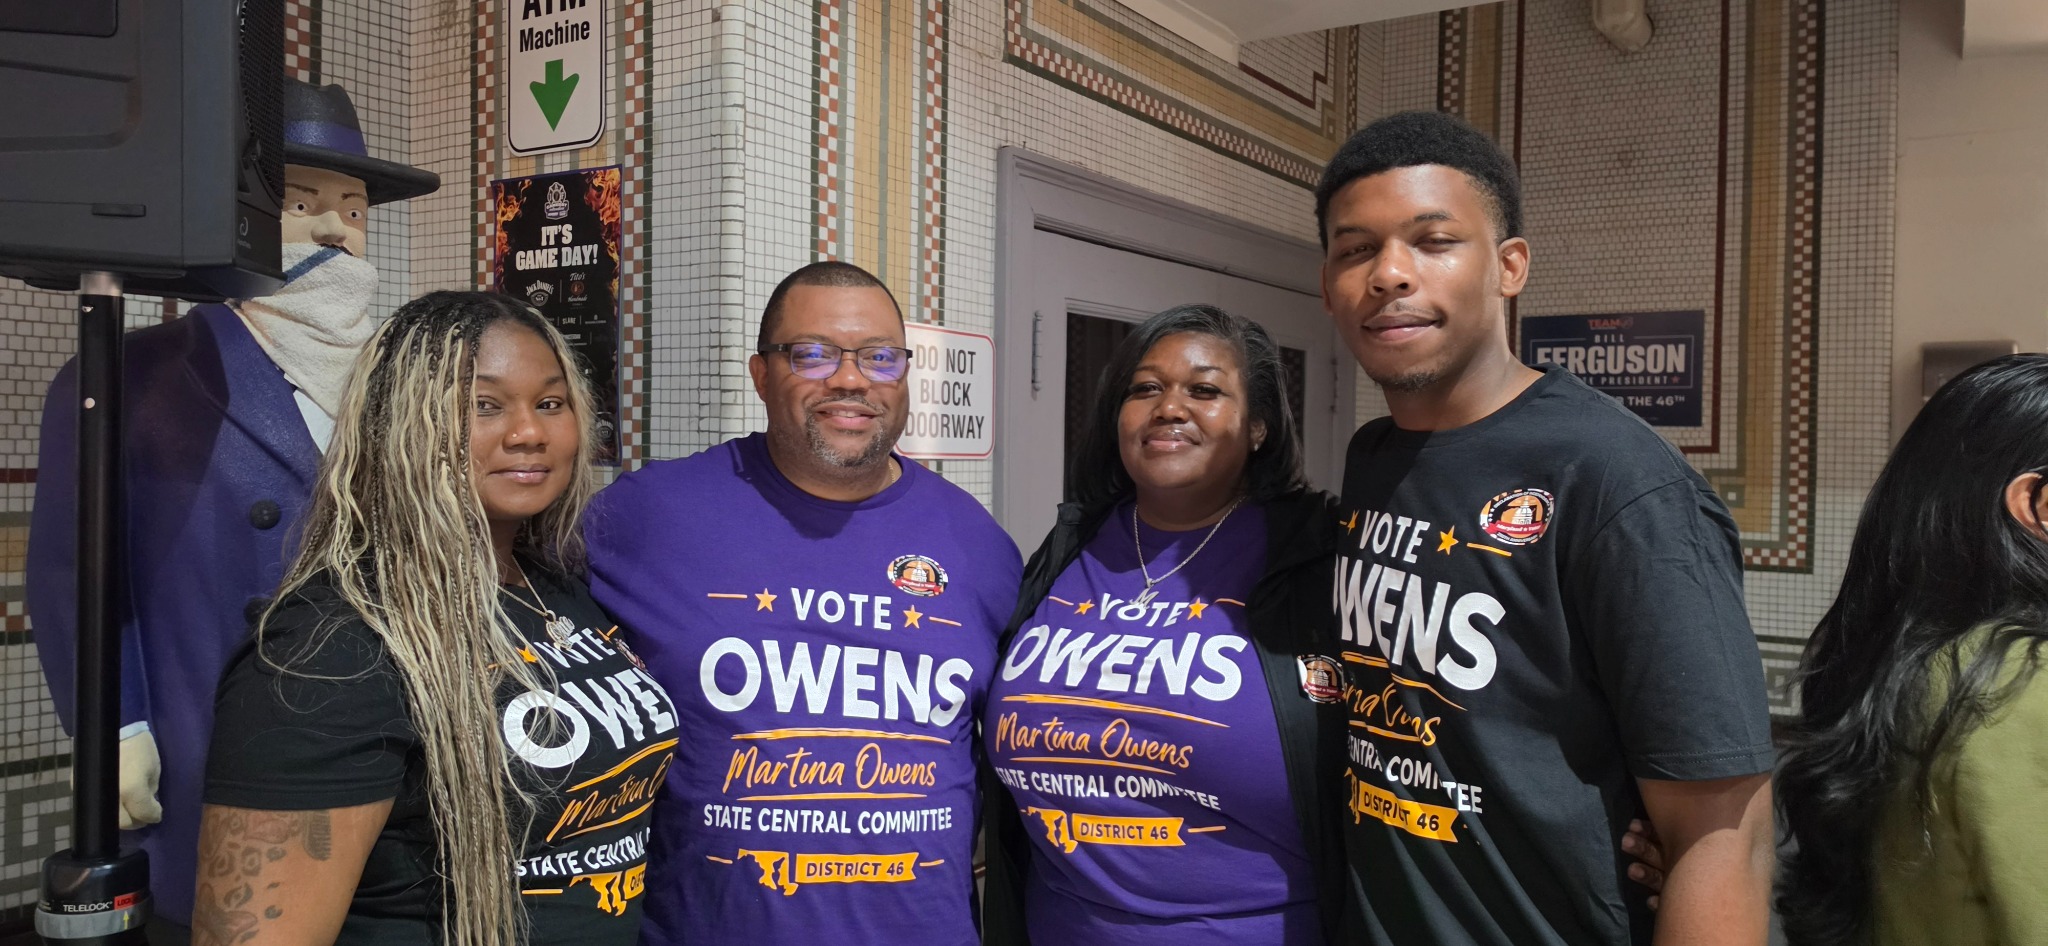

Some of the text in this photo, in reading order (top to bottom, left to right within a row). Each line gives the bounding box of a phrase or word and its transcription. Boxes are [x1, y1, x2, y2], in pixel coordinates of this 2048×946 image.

[520, 19, 590, 53] Machine
[541, 224, 573, 247] IT'S
[515, 244, 599, 271] GAME DAY!
[1594, 333, 1625, 343] BILL
[916, 344, 976, 375] DO NOT
[920, 379, 971, 407] BLOCK
[1601, 375, 1668, 385] PRESIDENT
[1627, 396, 1653, 406] THE
[905, 411, 985, 439] DOORWAY
[1359, 510, 1431, 564] VOTE
[791, 587, 892, 630] VOTE
[1100, 593, 1189, 627] VOTE
[1002, 624, 1248, 701] OWENS
[700, 637, 974, 727] OWENS
[996, 711, 1193, 769] Martina Owens
[722, 746, 845, 793] Martina
[856, 743, 936, 789] Owens
[1031, 771, 1109, 798] CENTRAL
[704, 803, 952, 835] STATE CENTRAL COMMITTEE
[1080, 822, 1169, 840] DISTRICT 46
[1417, 813, 1440, 832] 46
[514, 851, 583, 877] STATE
[806, 861, 905, 877] DISTRICT 46
